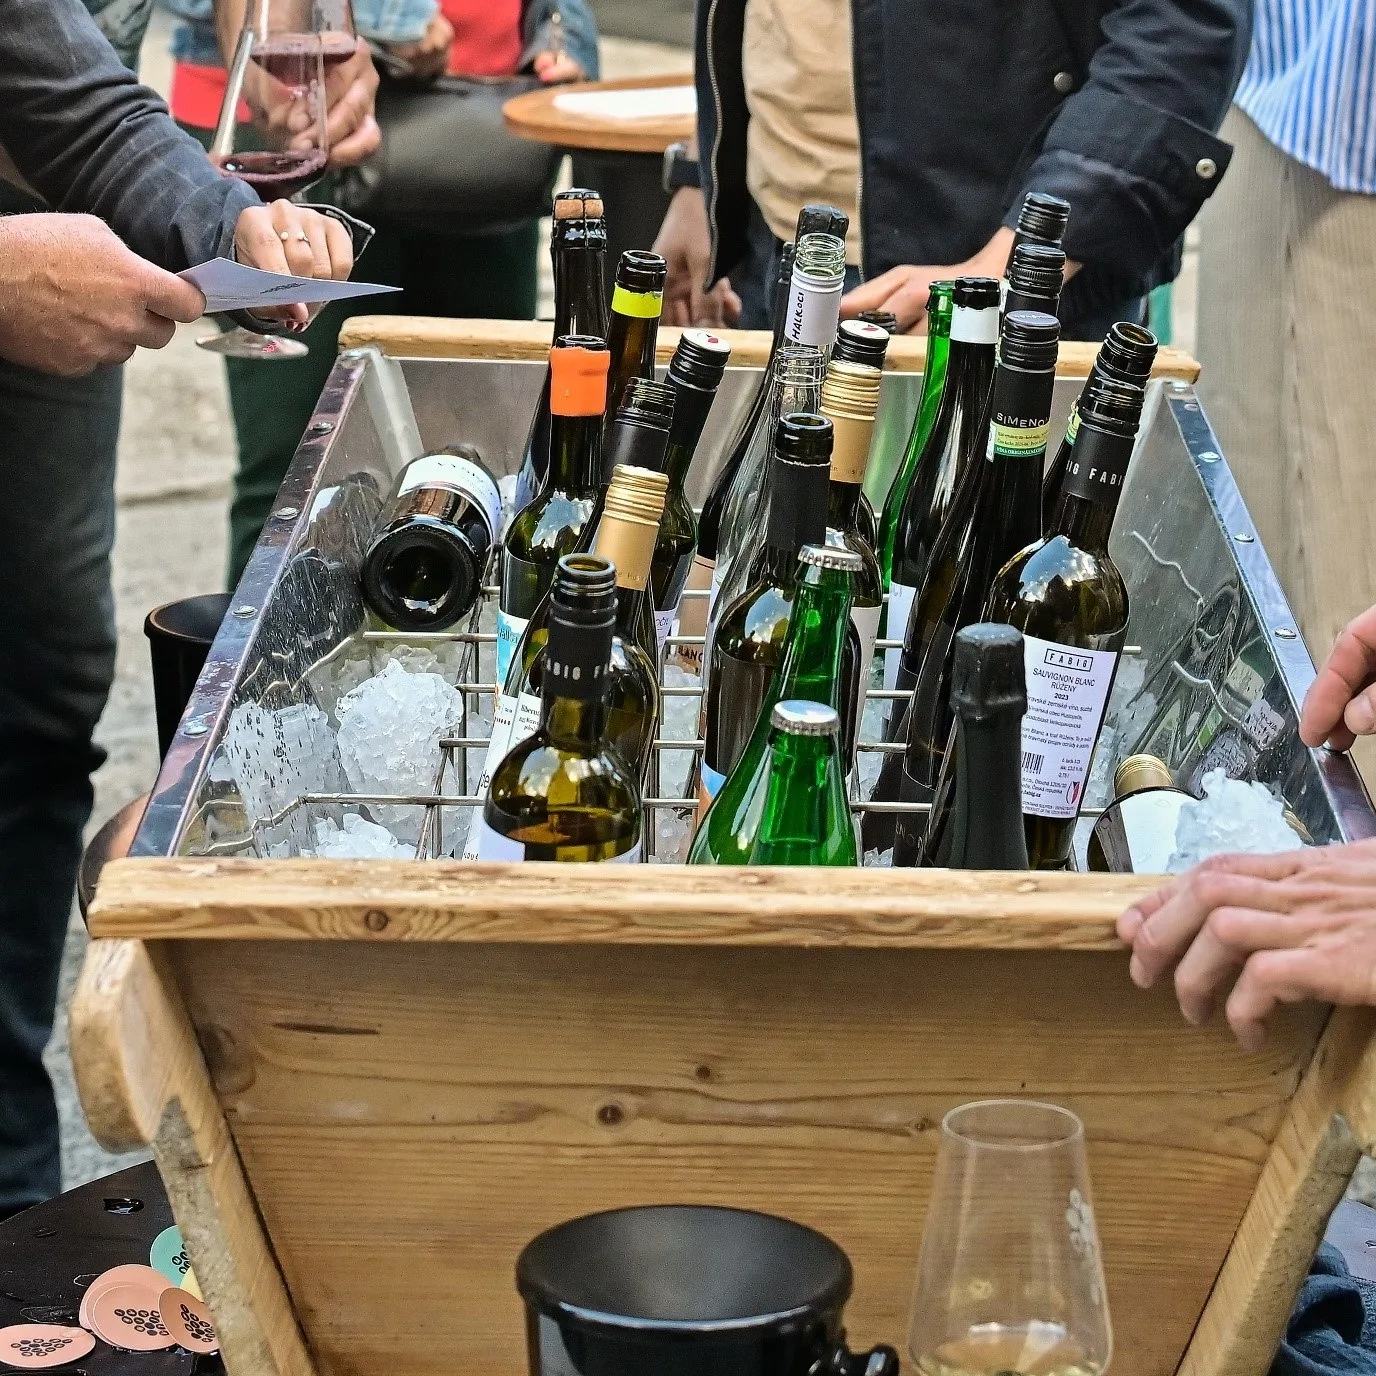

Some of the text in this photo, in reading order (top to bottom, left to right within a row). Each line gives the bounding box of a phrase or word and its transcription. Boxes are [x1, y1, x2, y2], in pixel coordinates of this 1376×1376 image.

[791, 291, 805, 341] HALKOCI
[996, 412, 1049, 428] SIMENO
[1049, 653, 1088, 668] FABIG
[1032, 667, 1096, 687] SAUVIGNON BLANC
[1054, 692, 1069, 701] 2023
